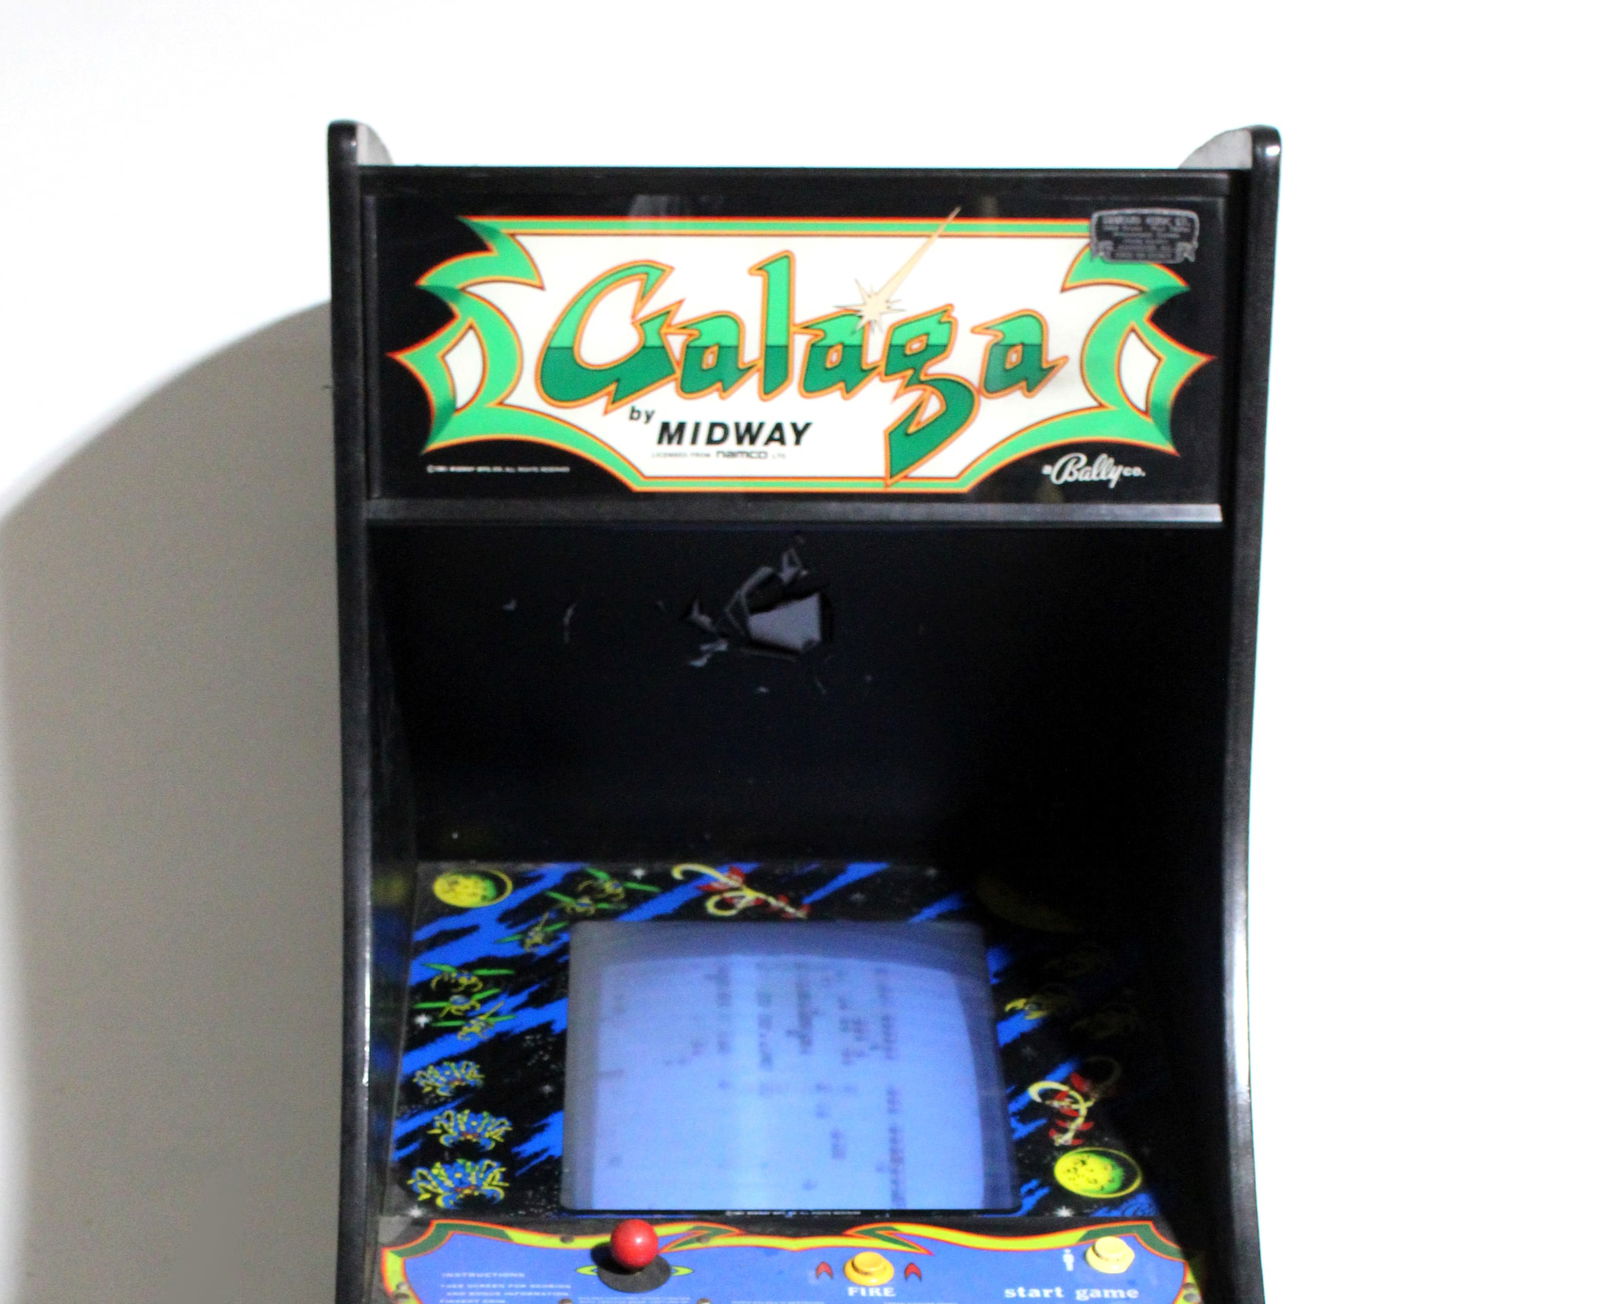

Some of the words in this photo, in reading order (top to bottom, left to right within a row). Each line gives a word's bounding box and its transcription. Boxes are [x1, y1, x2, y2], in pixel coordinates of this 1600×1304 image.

[535, 250, 1069, 487] Galaga
[629, 406, 655, 424] by
[657, 421, 813, 446] MIDWAY
[715, 450, 769, 461] namco
[1050, 452, 1123, 489] Bally
[847, 1286, 897, 1298] FIRE
[1004, 1285, 1064, 1299] start
[1076, 1286, 1139, 1301] game
